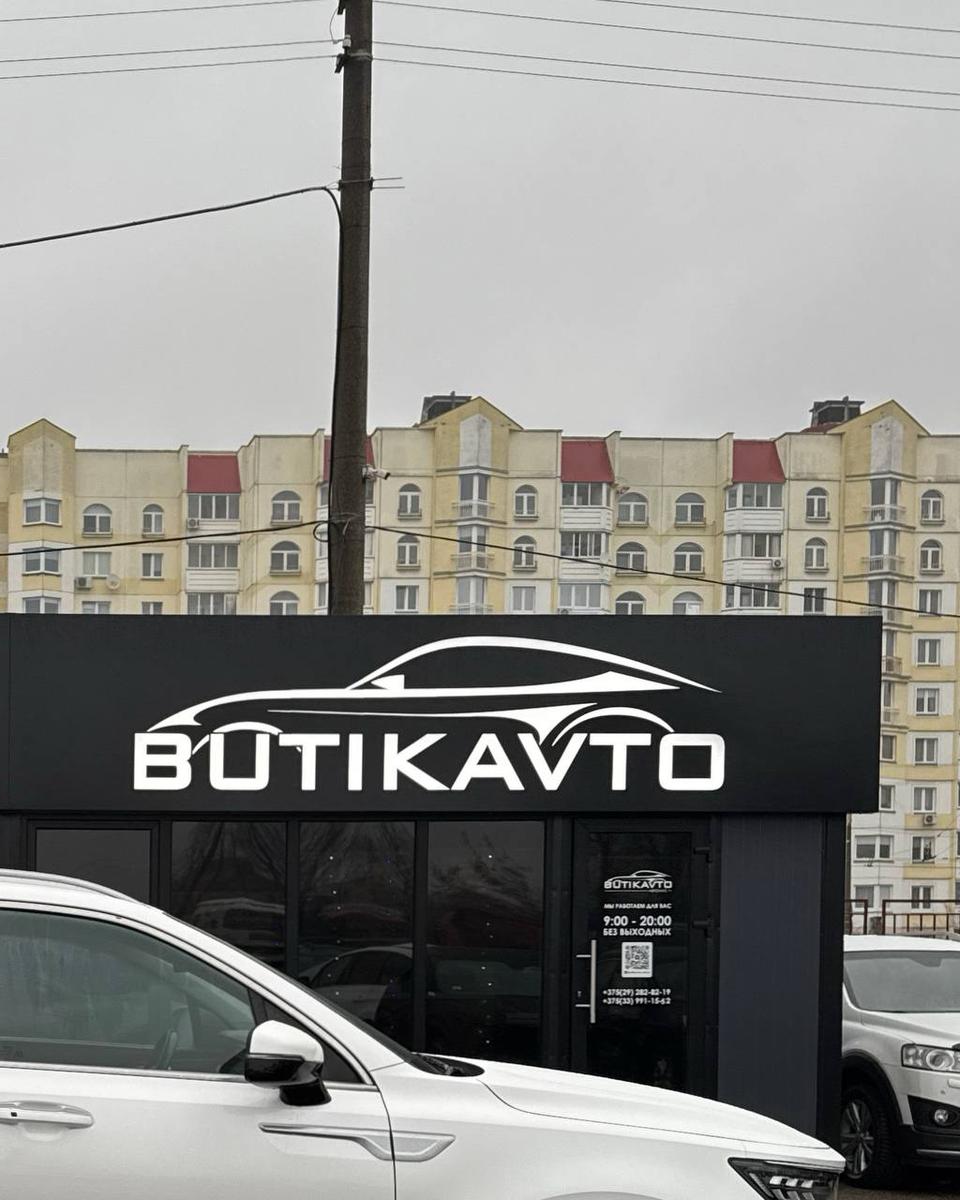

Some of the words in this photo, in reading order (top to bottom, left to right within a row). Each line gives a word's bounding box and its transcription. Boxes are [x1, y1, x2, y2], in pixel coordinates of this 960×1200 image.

[133, 732, 725, 791] BUTIKAVTO
[603, 880, 673, 889] BUTIKAVTO
[603, 915, 629, 926] 9:00
[639, 915, 672, 926] 20:00
[603, 928, 618, 936] БЕЗ
[619, 928, 672, 937] ВЫХОДНЫХ
[602, 988, 634, 996] +375(29)
[602, 997, 634, 1005] +375(33)
